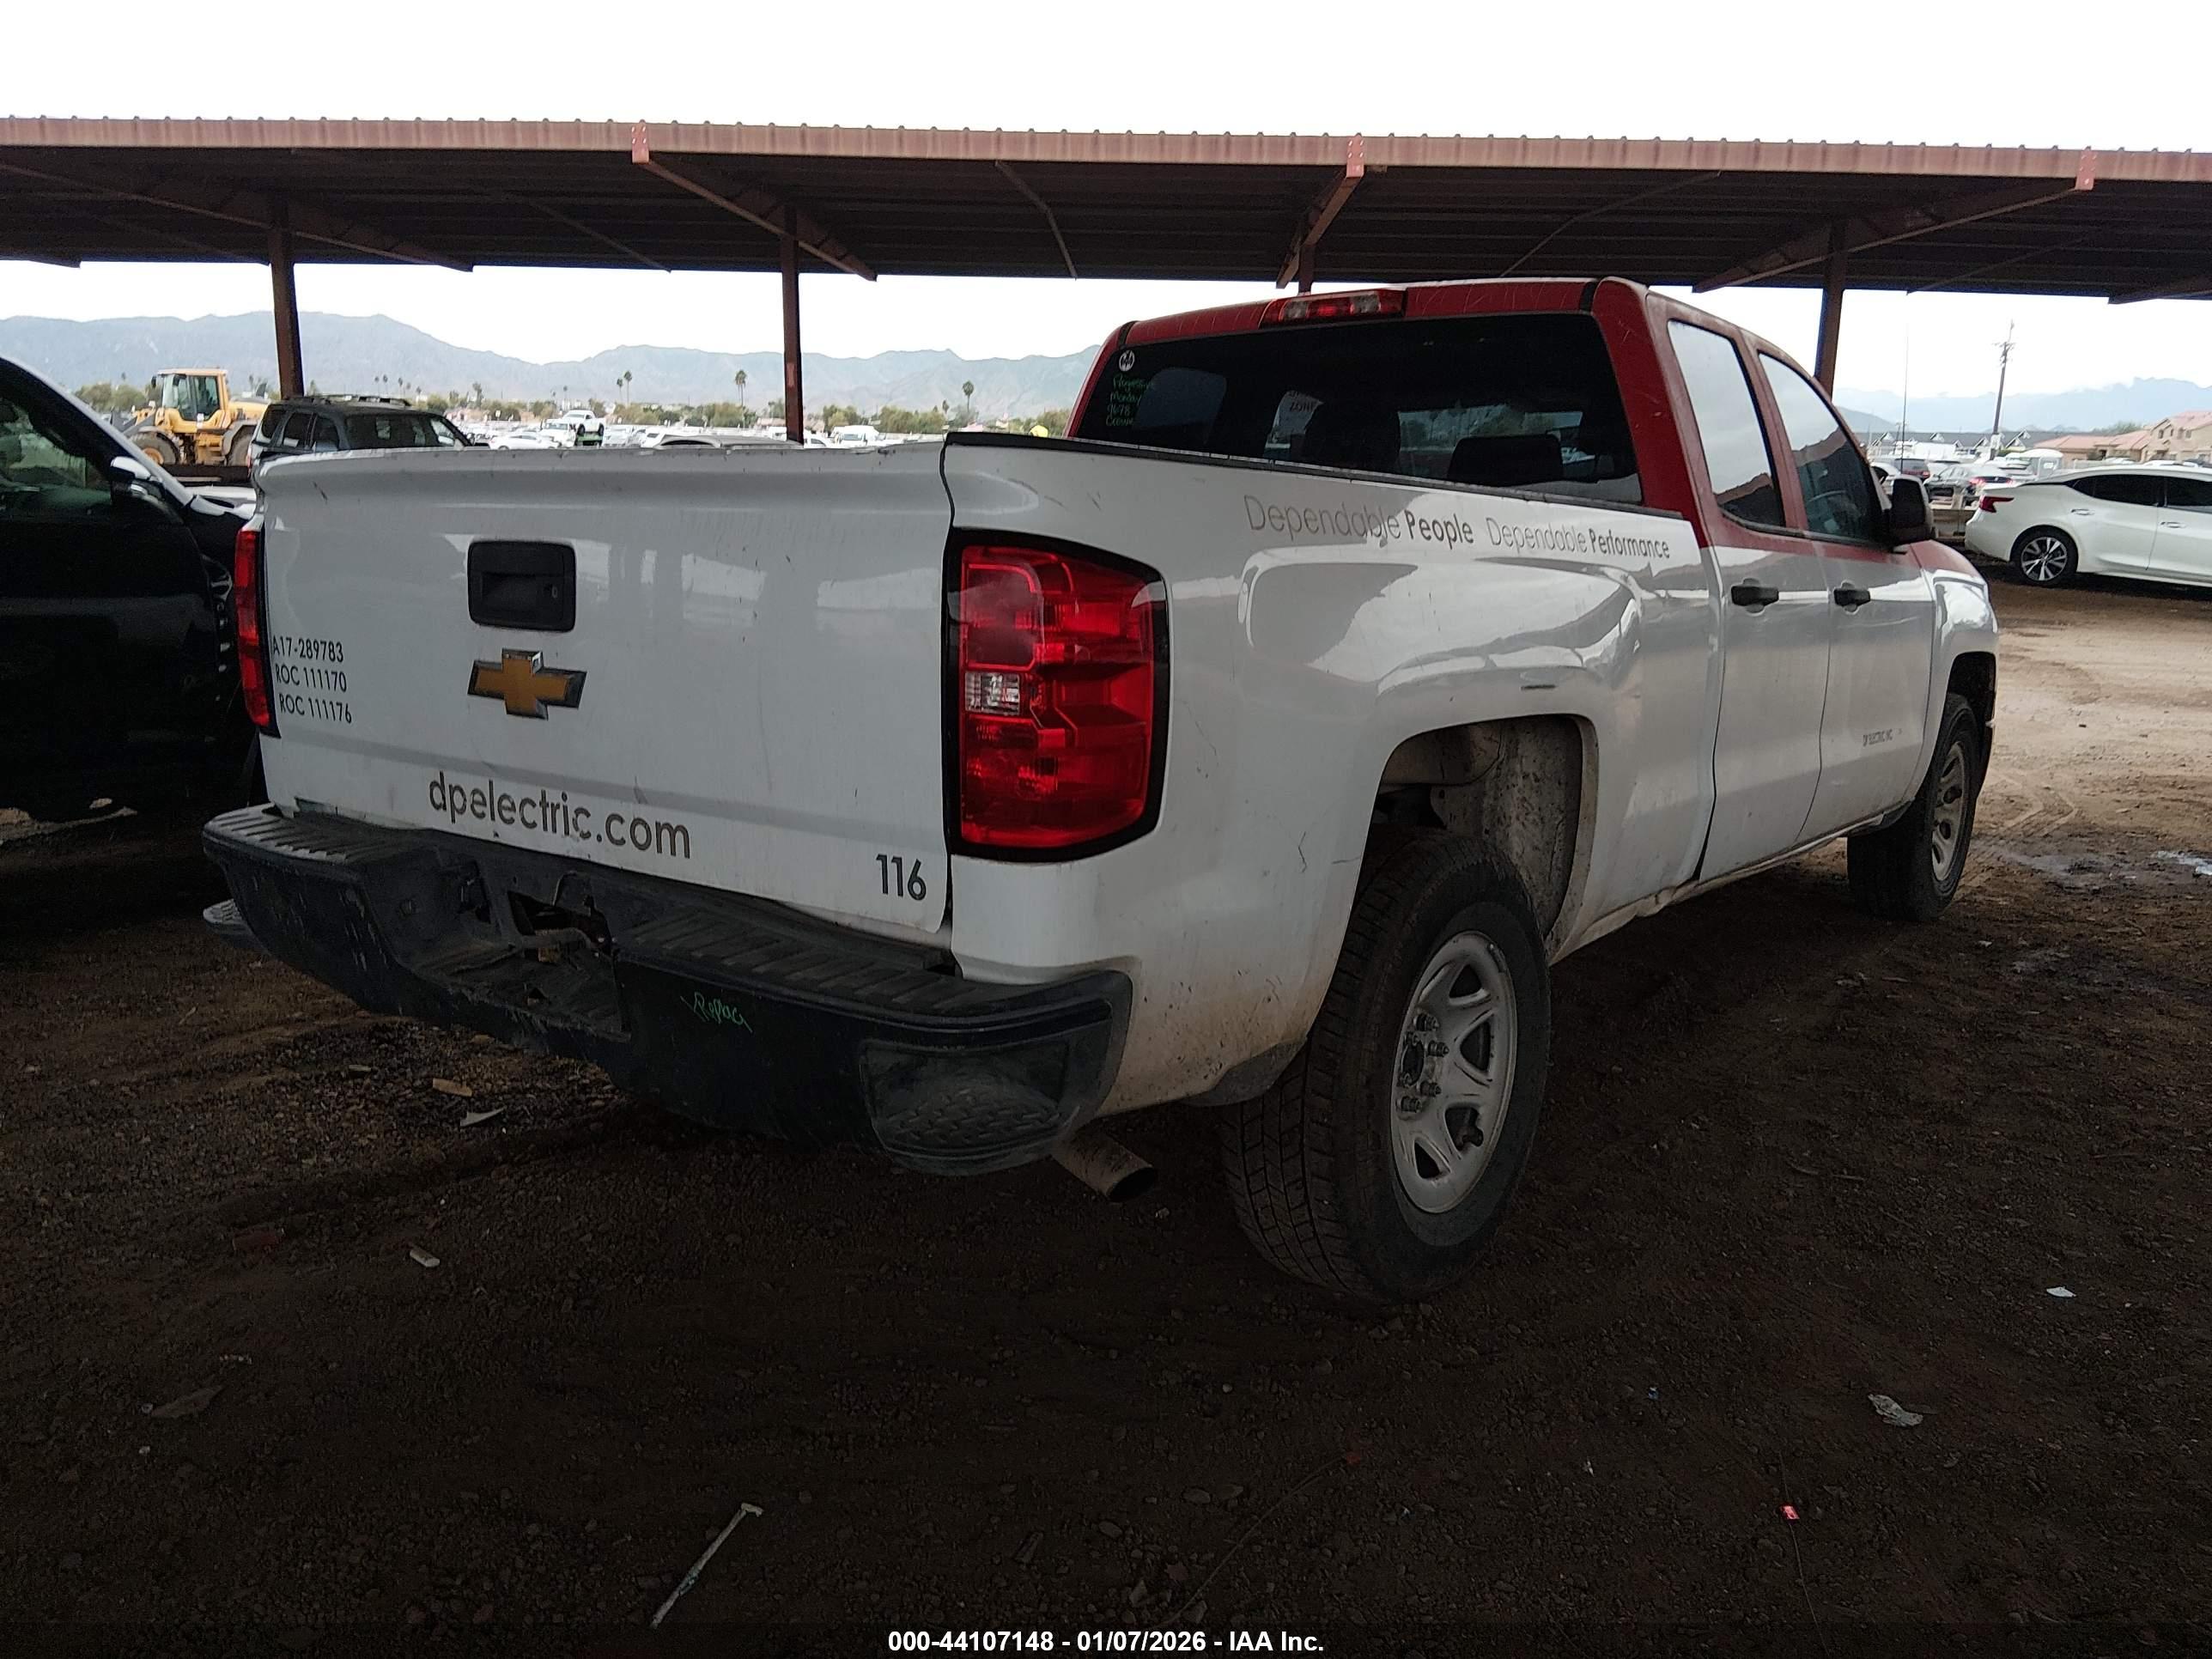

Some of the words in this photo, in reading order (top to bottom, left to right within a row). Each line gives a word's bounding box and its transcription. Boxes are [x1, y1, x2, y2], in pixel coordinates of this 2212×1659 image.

[1244, 495, 1401, 543] Dependable
[1405, 510, 1474, 549] People
[1487, 517, 1587, 553] Dependable
[1589, 527, 1670, 559] Performance
[272, 635, 344, 663] A17-289783
[275, 664, 301, 686] ROC
[303, 667, 348, 693] 111170
[279, 693, 305, 715] ROC
[307, 698, 352, 724] 111176
[428, 770, 690, 859] dpelectric.com
[875, 854, 927, 901] 116
